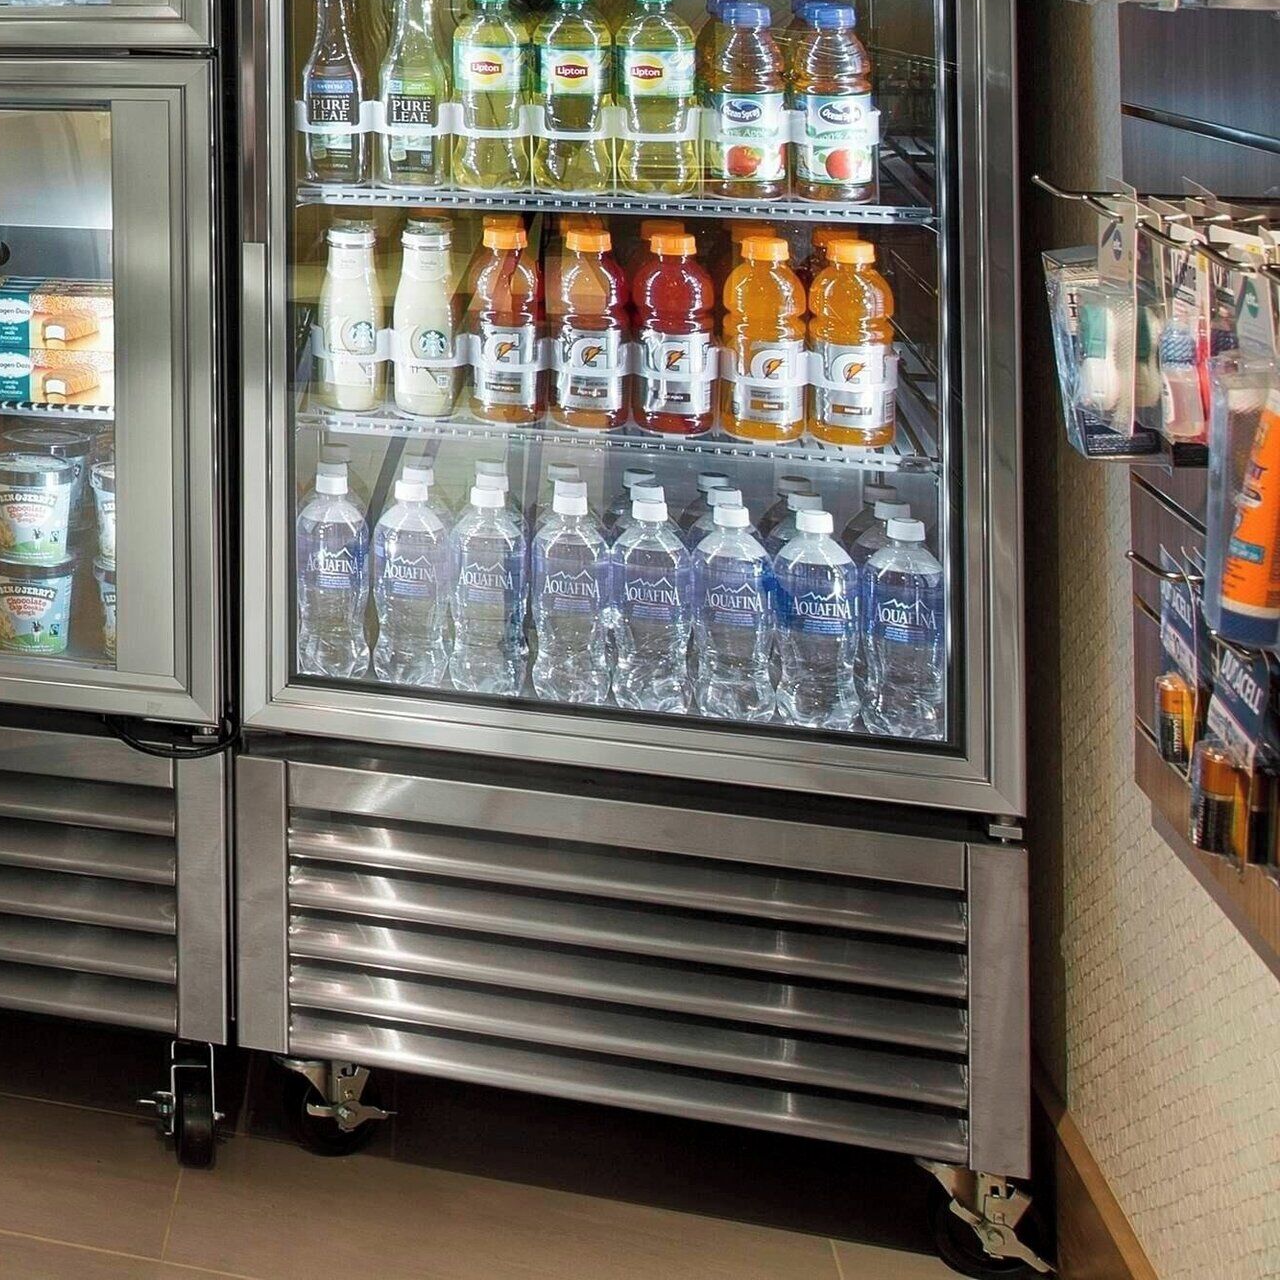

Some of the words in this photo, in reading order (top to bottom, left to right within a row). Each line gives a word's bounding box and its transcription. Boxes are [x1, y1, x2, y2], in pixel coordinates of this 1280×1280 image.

[472, 64, 500, 75] Lipton
[556, 67, 587, 78] Lipton
[631, 67, 661, 78] Lipton
[312, 98, 350, 111] PURE
[392, 100, 432, 113] PURE
[383, 559, 438, 583] AQUAFINA
[458, 569, 514, 591] AQUAFINA
[543, 576, 600, 598] AQUAFINA
[623, 583, 680, 606] AQUAFINA
[705, 590, 763, 612] AQUAFINA
[792, 594, 852, 620] AQUAFINA
[875, 601, 937, 629] AQUAFINA
